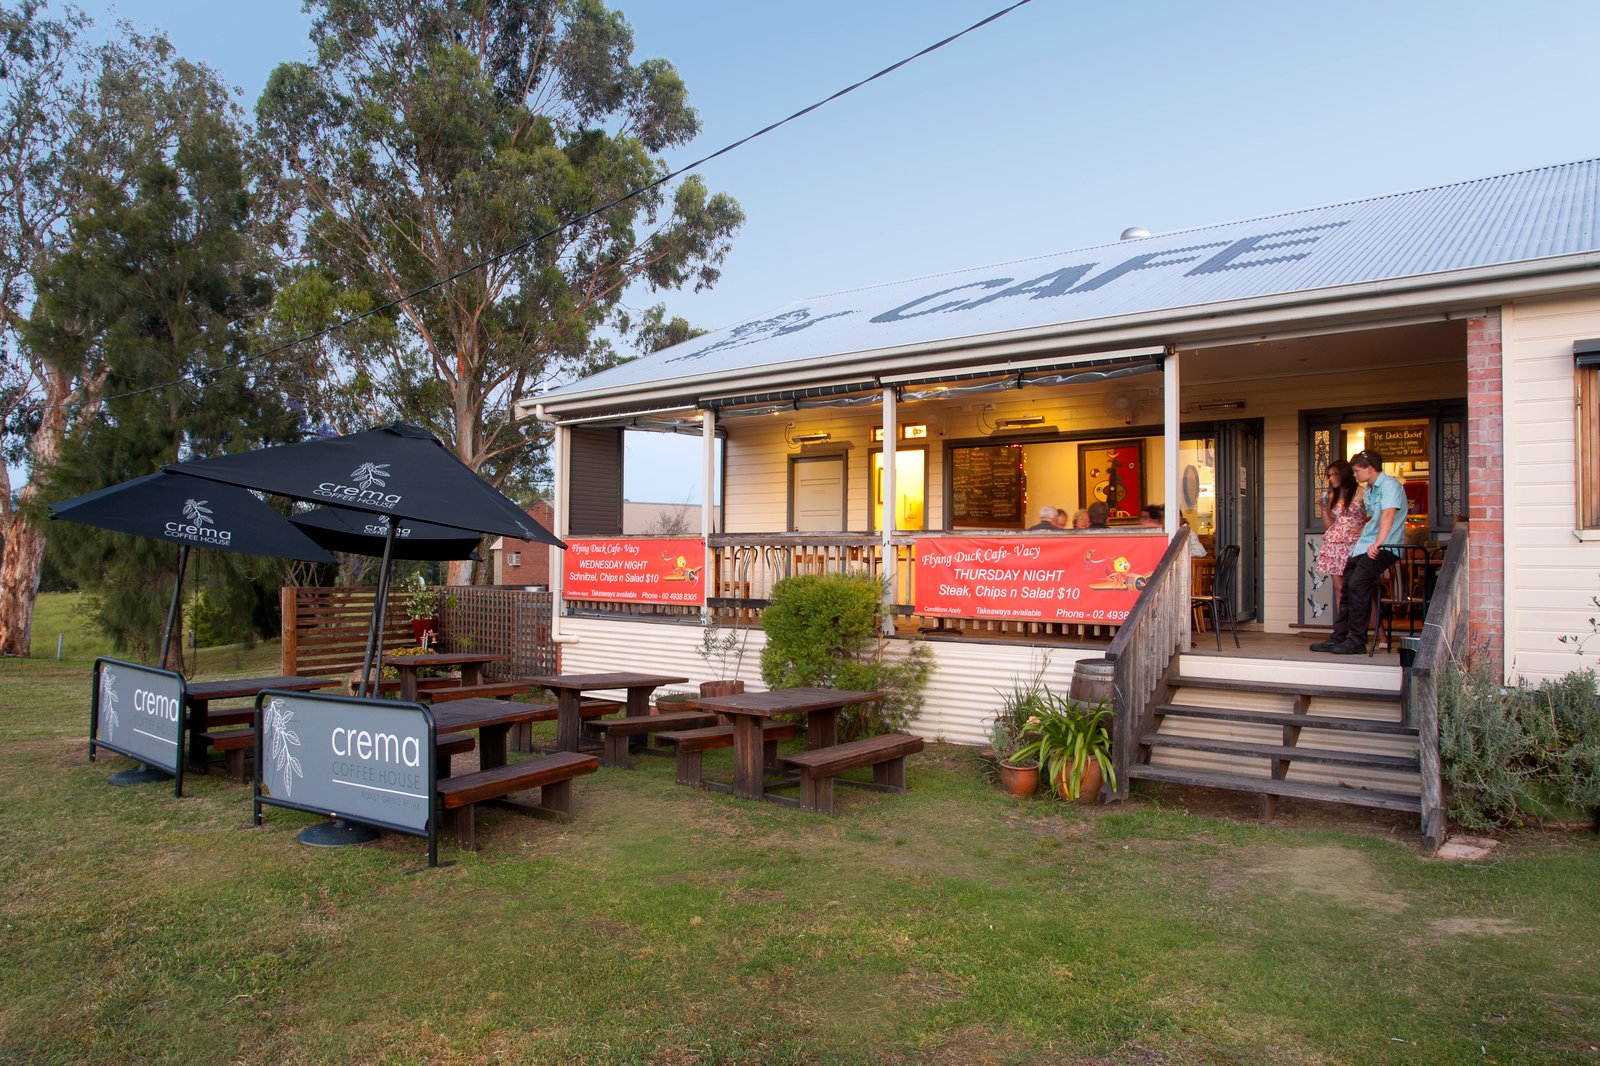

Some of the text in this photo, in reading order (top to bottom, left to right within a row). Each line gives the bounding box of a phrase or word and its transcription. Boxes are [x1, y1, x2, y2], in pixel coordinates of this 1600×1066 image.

[869, 220, 1352, 324] CAFE
[313, 489, 396, 509] COFFEE HOUSE
[319, 482, 402, 504] crema
[164, 530, 231, 546] COFFEE HOUSE
[165, 522, 232, 540] crema
[572, 543, 590, 556] Flying
[590, 542, 607, 554] Duck
[922, 552, 952, 568] Flying
[954, 548, 984, 562] Duck
[1014, 544, 1040, 560] Vacy
[580, 560, 648, 570] WEDNESDAY NIGHT
[570, 572, 598, 582] Schnitzel,
[600, 572, 618, 583] Chips
[625, 572, 644, 582] Salad
[646, 574, 659, 584] $10
[954, 568, 1064, 582] THURSDAY NIGHT
[592, 590, 616, 598] Takeaways
[938, 584, 1080, 600] Steak, Chips n Salad $10
[976, 606, 1011, 616] Takeaways
[1012, 608, 1042, 617] available
[1056, 608, 1084, 618] Phone
[1092, 610, 1104, 619] 02
[134, 688, 179, 722] crema
[331, 727, 420, 767] crema
[332, 761, 420, 790] COFFEE HOUSE
